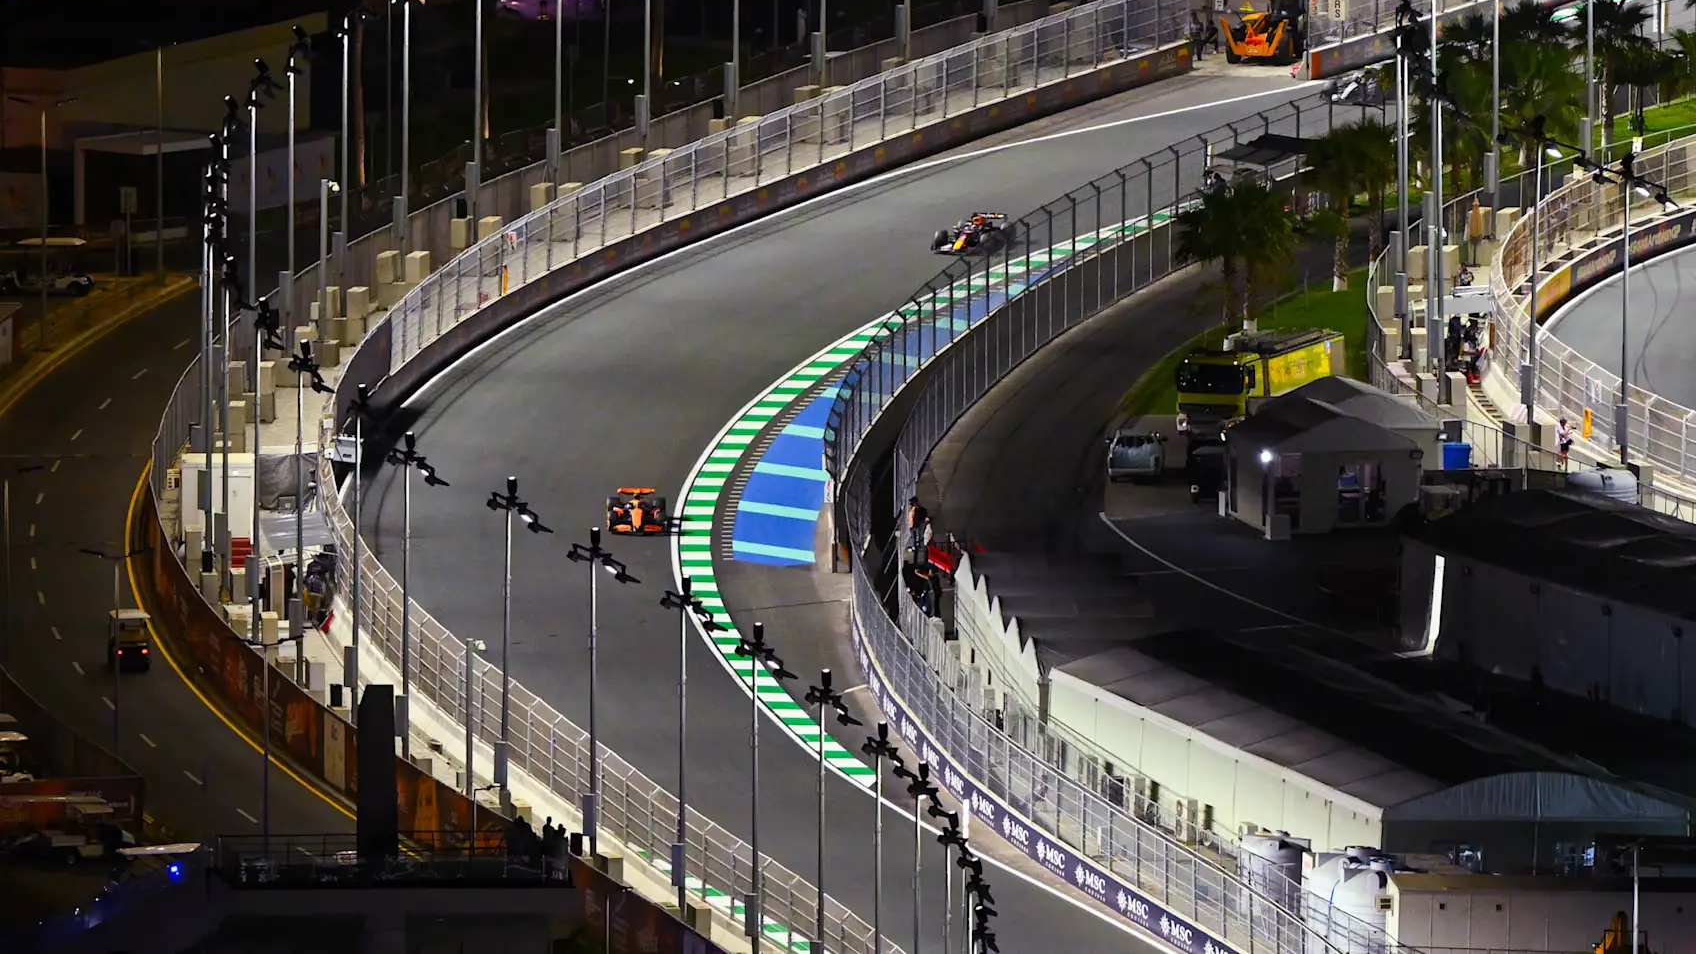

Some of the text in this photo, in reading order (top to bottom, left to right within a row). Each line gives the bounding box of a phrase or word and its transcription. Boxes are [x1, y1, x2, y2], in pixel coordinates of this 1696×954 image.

[927, 746, 940, 770] MSC
[950, 771, 964, 795] MSC
[979, 795, 994, 820] MSC
[1011, 820, 1029, 845] MSC
[1045, 842, 1065, 869] MSC
[1084, 869, 1105, 894] MSC
[1127, 897, 1149, 920] MSC
[1170, 920, 1192, 945] MSC
